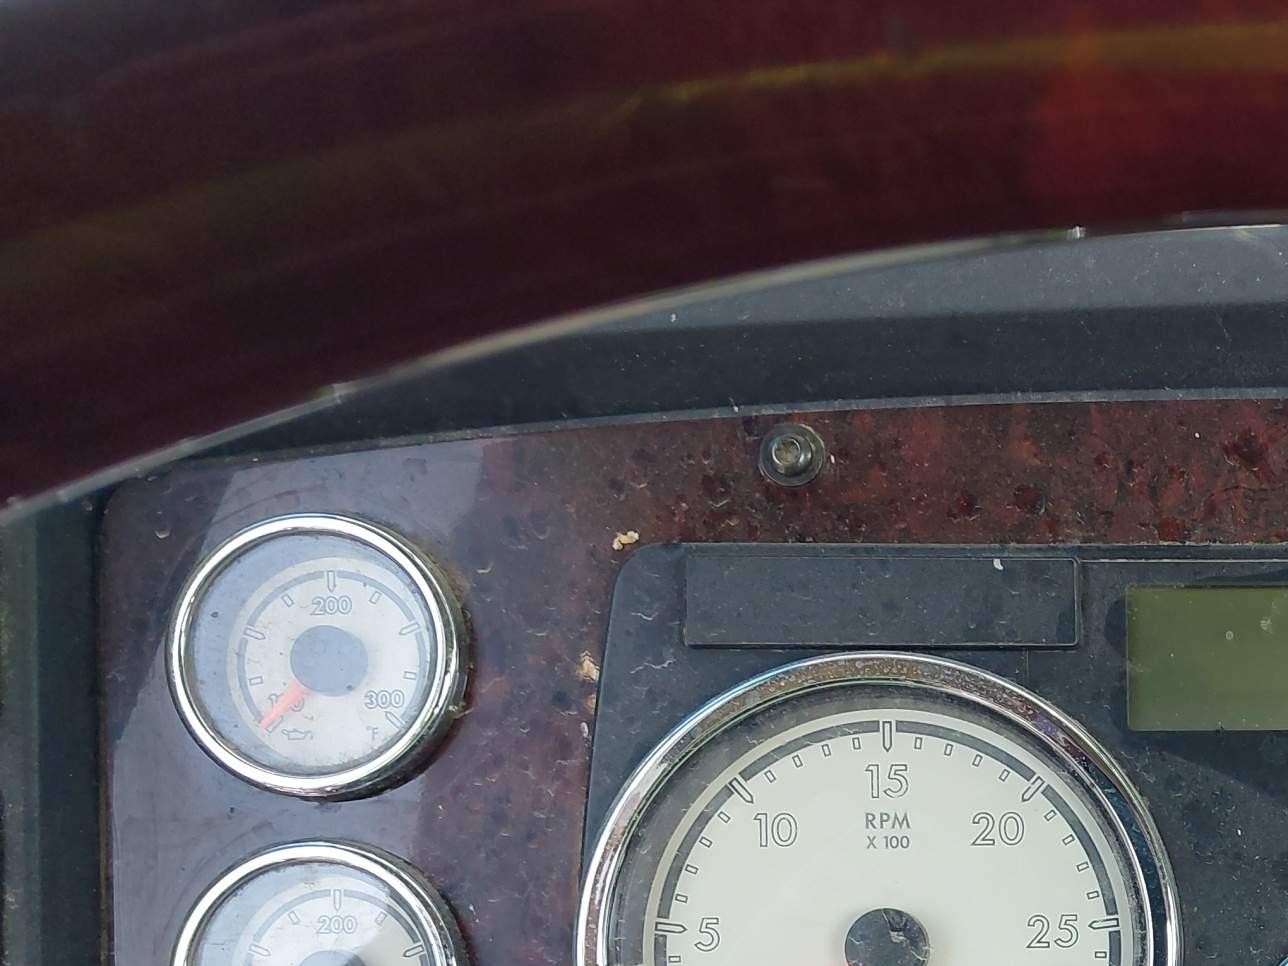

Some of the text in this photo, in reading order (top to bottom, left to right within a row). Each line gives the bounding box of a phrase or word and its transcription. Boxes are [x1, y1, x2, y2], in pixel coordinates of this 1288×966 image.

[310, 596, 352, 616] 200
[365, 690, 405, 709] 300
[864, 764, 909, 799] 15
[754, 812, 798, 847] 10
[864, 812, 910, 830] RPM
[971, 812, 1024, 847] 20
[866, 836, 910, 849] X 100
[317, 916, 357, 934] 200
[695, 917, 720, 952] 5
[1026, 914, 1079, 949] 25
